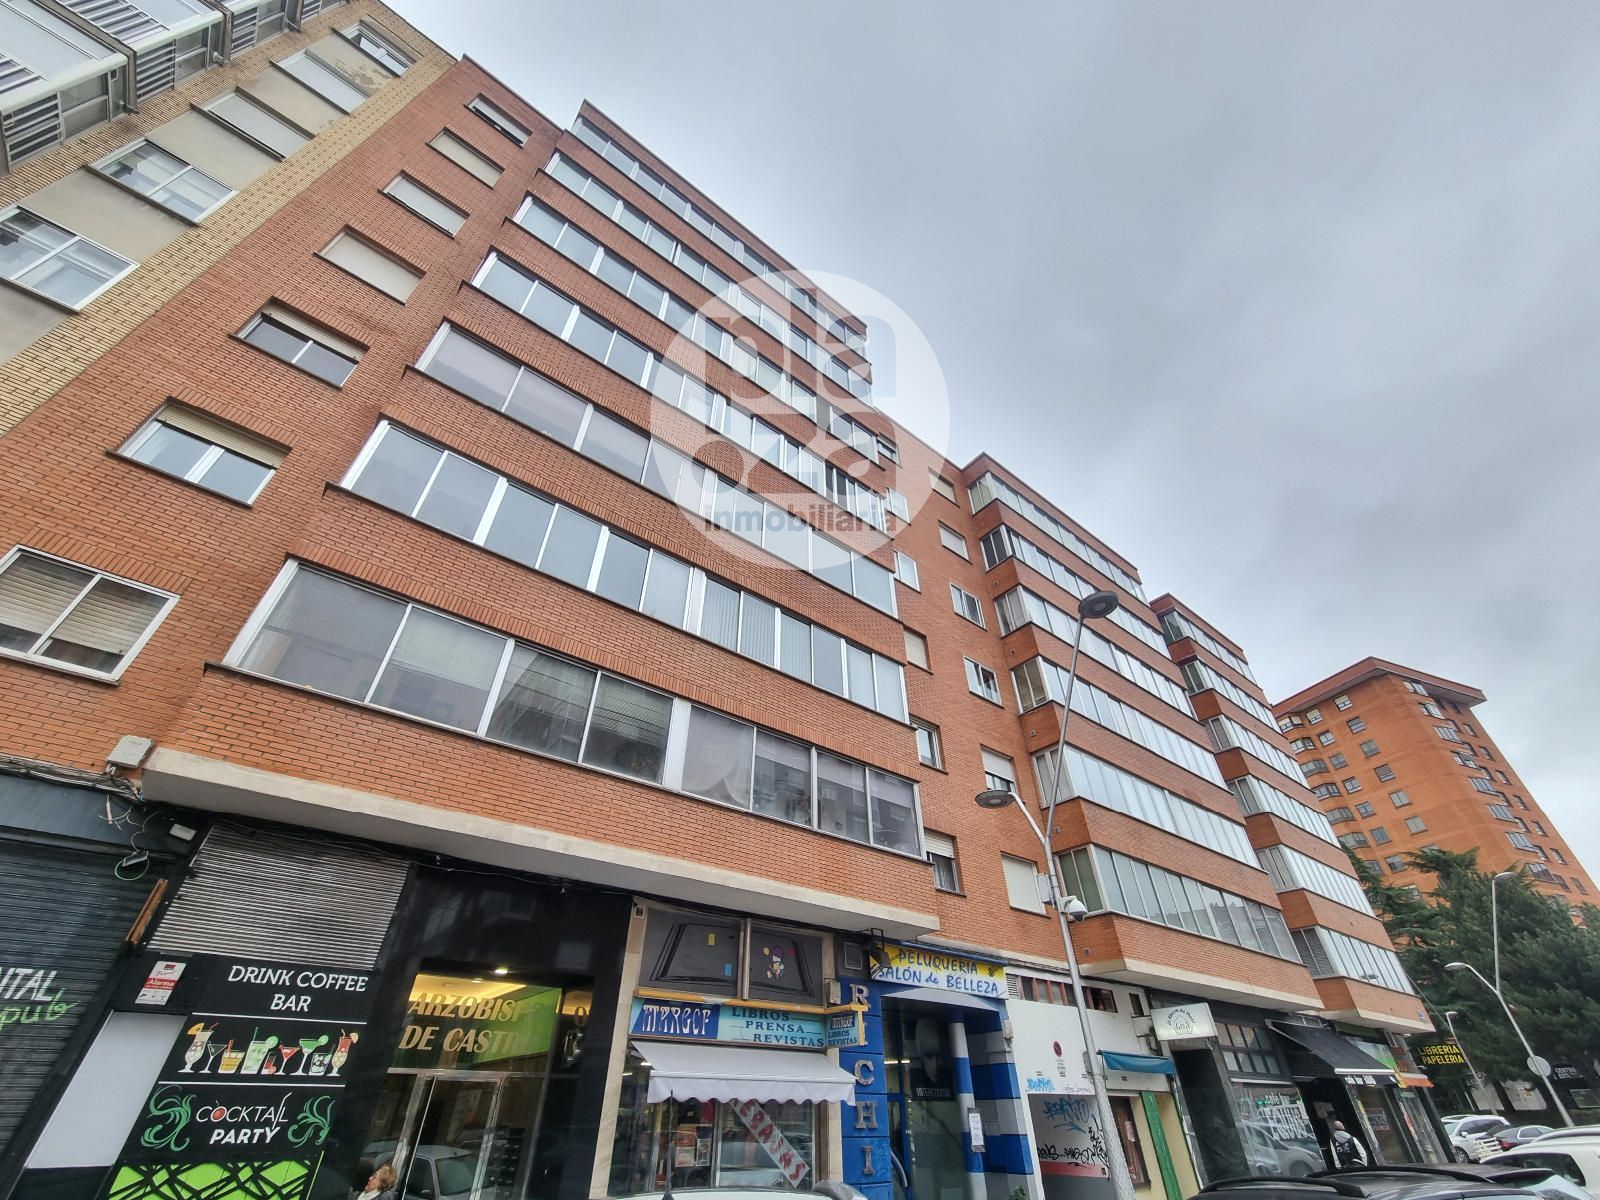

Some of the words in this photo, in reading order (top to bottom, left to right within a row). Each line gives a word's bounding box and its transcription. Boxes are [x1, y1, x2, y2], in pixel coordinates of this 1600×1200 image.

[0, 967, 57, 1001] ITAL
[227, 965, 295, 986] DRINK
[296, 971, 369, 992] COFFEE
[924, 972, 939, 984] de
[946, 974, 999, 994] BELLEZA
[270, 993, 311, 1012] BAR
[731, 1006, 791, 1022] LIBROS
[745, 1020, 805, 1033] PRENSA
[828, 1029, 850, 1039] LIBROS
[399, 1025, 440, 1051] DE
[753, 1033, 825, 1047] REVISTAS
[1418, 1045, 1460, 1055] LIBRERIA
[1422, 1054, 1465, 1064] PAPELERIA
[196, 1092, 293, 1129] COCKTAIL
[209, 1126, 280, 1145] PARTY
[734, 1099, 806, 1181] EBAJAS
